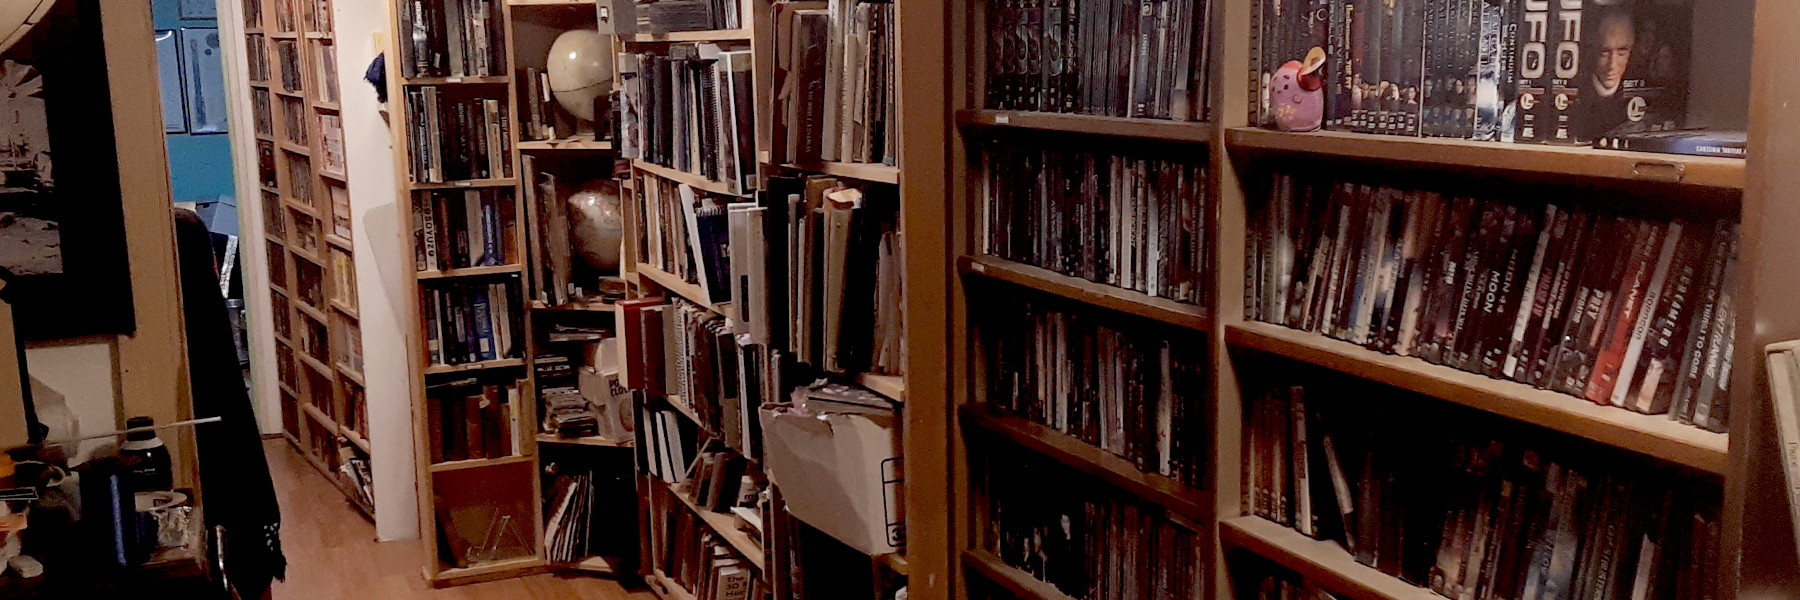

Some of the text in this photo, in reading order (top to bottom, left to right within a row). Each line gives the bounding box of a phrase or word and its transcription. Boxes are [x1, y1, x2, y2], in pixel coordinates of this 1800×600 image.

[1507, 23, 1518, 84] CONTINUUM
[1623, 80, 1637, 88] SET
[1483, 270, 1501, 314] MOON
[1586, 287, 1604, 320] PREY
[1624, 261, 1647, 319] PLANET
[1695, 335, 1706, 350] TO
